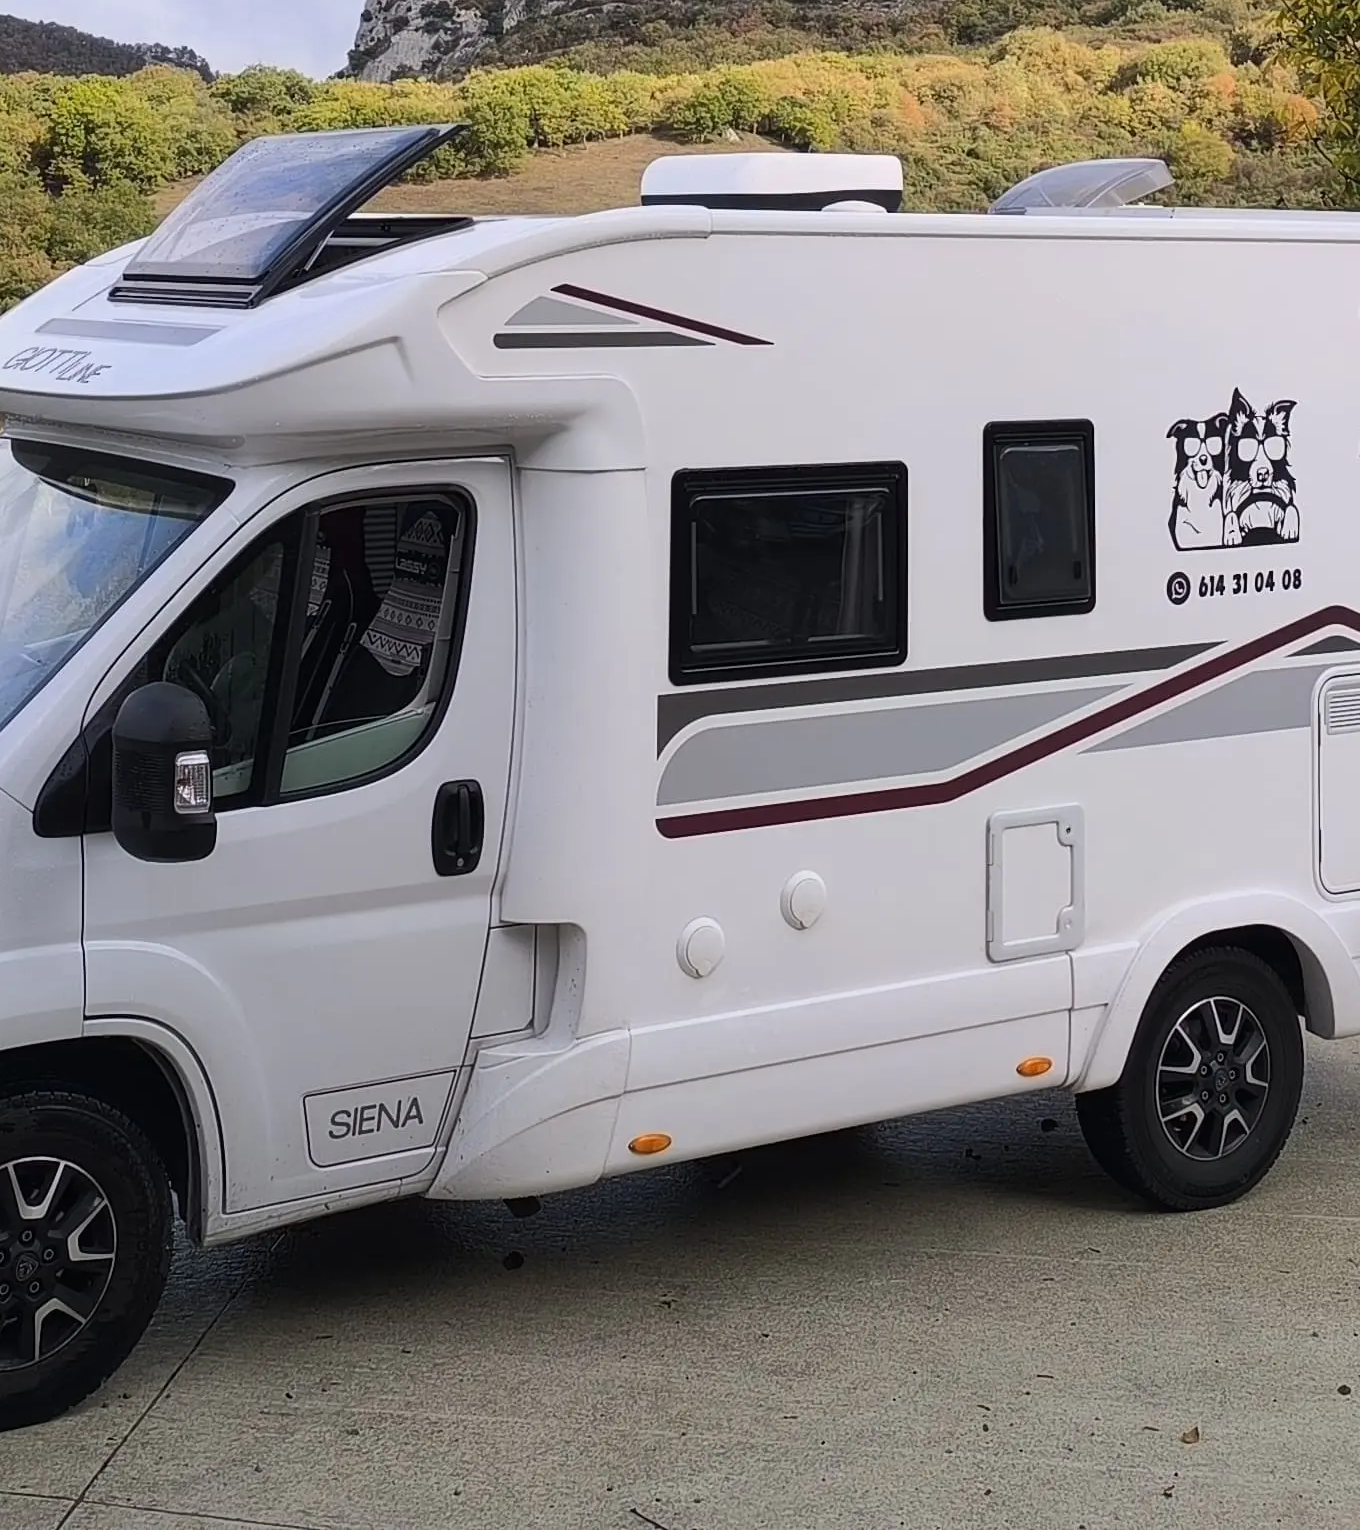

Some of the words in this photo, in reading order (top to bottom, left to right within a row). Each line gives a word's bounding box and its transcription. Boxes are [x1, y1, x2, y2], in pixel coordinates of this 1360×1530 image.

[1199, 574, 1225, 597] 614
[1232, 572, 1247, 594] 31
[1254, 570, 1275, 592] 04
[1282, 569, 1301, 590] 08
[328, 1096, 423, 1139] SIENA
